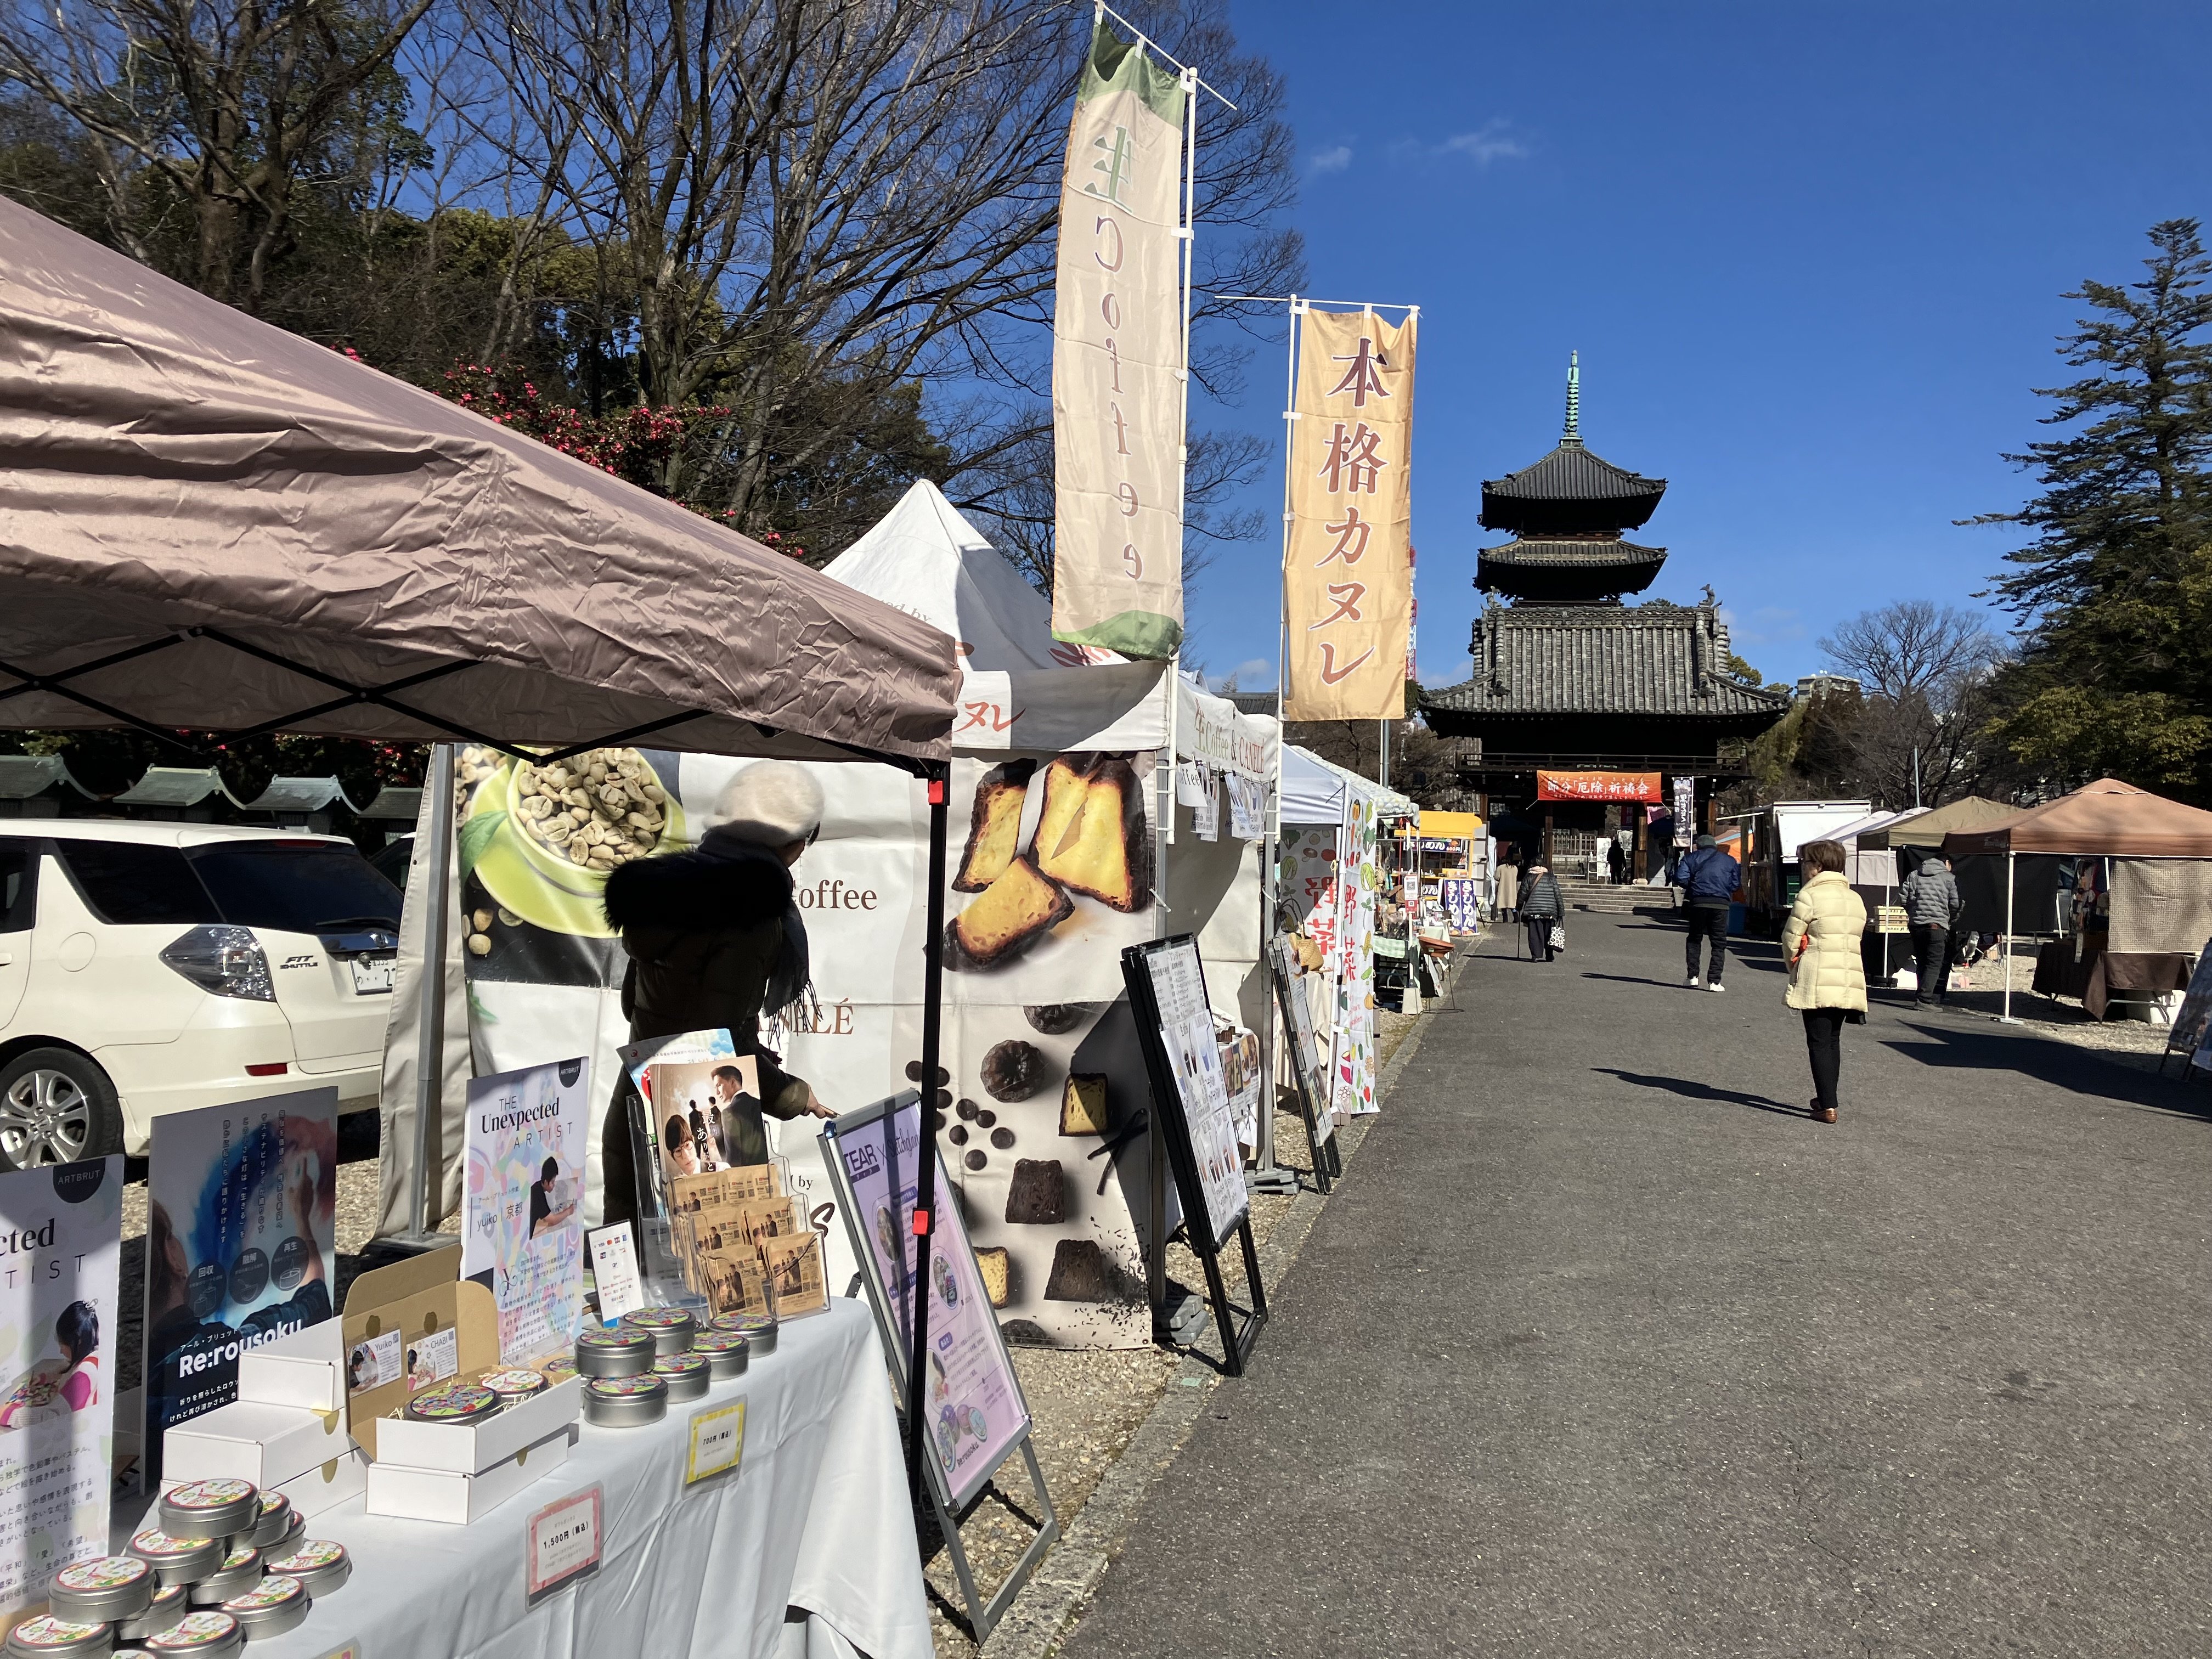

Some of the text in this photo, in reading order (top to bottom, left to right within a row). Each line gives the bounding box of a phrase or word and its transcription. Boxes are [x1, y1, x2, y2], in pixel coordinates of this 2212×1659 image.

[1309, 336, 1391, 686] 本格カヌレ
[1176, 768, 1200, 786] offee
[792, 879, 877, 911] offee
[1463, 880, 1475, 927] きしめん
[1344, 884, 1357, 981] 野菜
[285, 955, 313, 963] FIT
[499, 1096, 517, 1111] THE
[482, 1097, 560, 1134] Unexpected
[514, 1122, 573, 1150] ARTIST
[58, 1169, 101, 1186] ARTBRUT
[799, 1175, 813, 1190] by
[506, 1201, 523, 1219] 京都
[477, 1214, 498, 1232] yuiko
[284, 1240, 298, 1254] 再生
[198, 1265, 215, 1279] 回収
[179, 1318, 302, 1379] Re:rousoku
[180, 1328, 239, 1352] アール・ブリュット
[375, 1340, 393, 1352] Yuiko
[431, 1335, 449, 1349] CHABI
